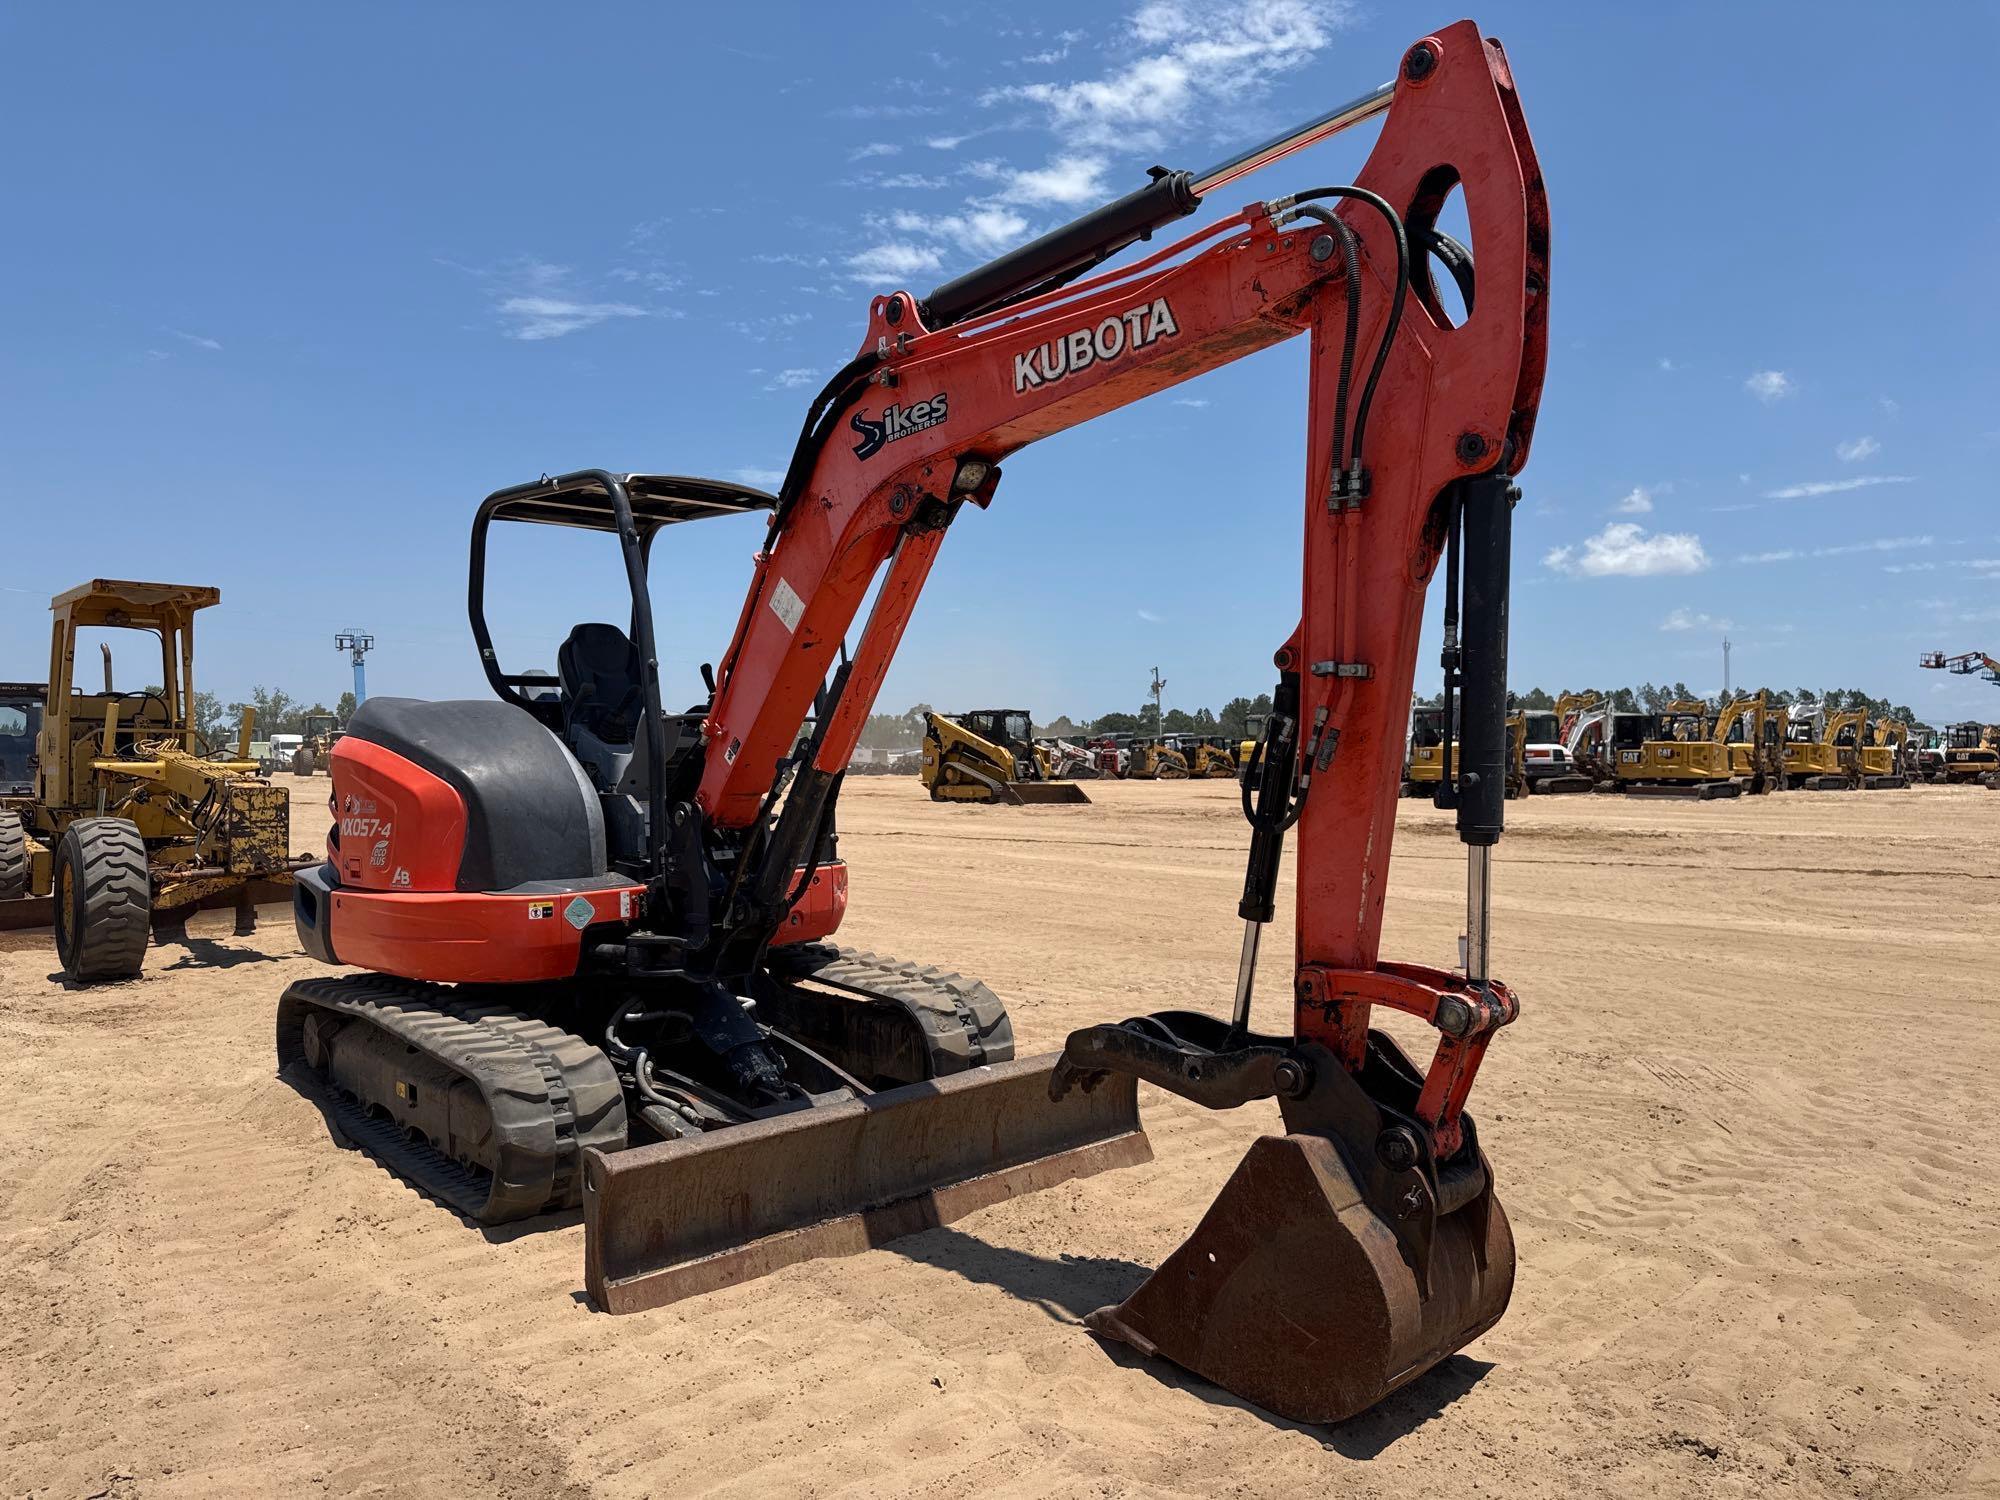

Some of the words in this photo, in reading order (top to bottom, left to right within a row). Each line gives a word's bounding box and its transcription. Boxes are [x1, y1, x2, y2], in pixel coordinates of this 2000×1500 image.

[1013, 297, 1178, 393] KUBOTA
[851, 393, 948, 462] Sikes
[887, 418, 937, 442] BROTHERS
[1622, 751, 1639, 763] CAT
[1657, 748, 1671, 757] CAT
[1956, 752, 1970, 761] CAT
[340, 818, 392, 837] KX057-4
[370, 857, 386, 866] PLUS
